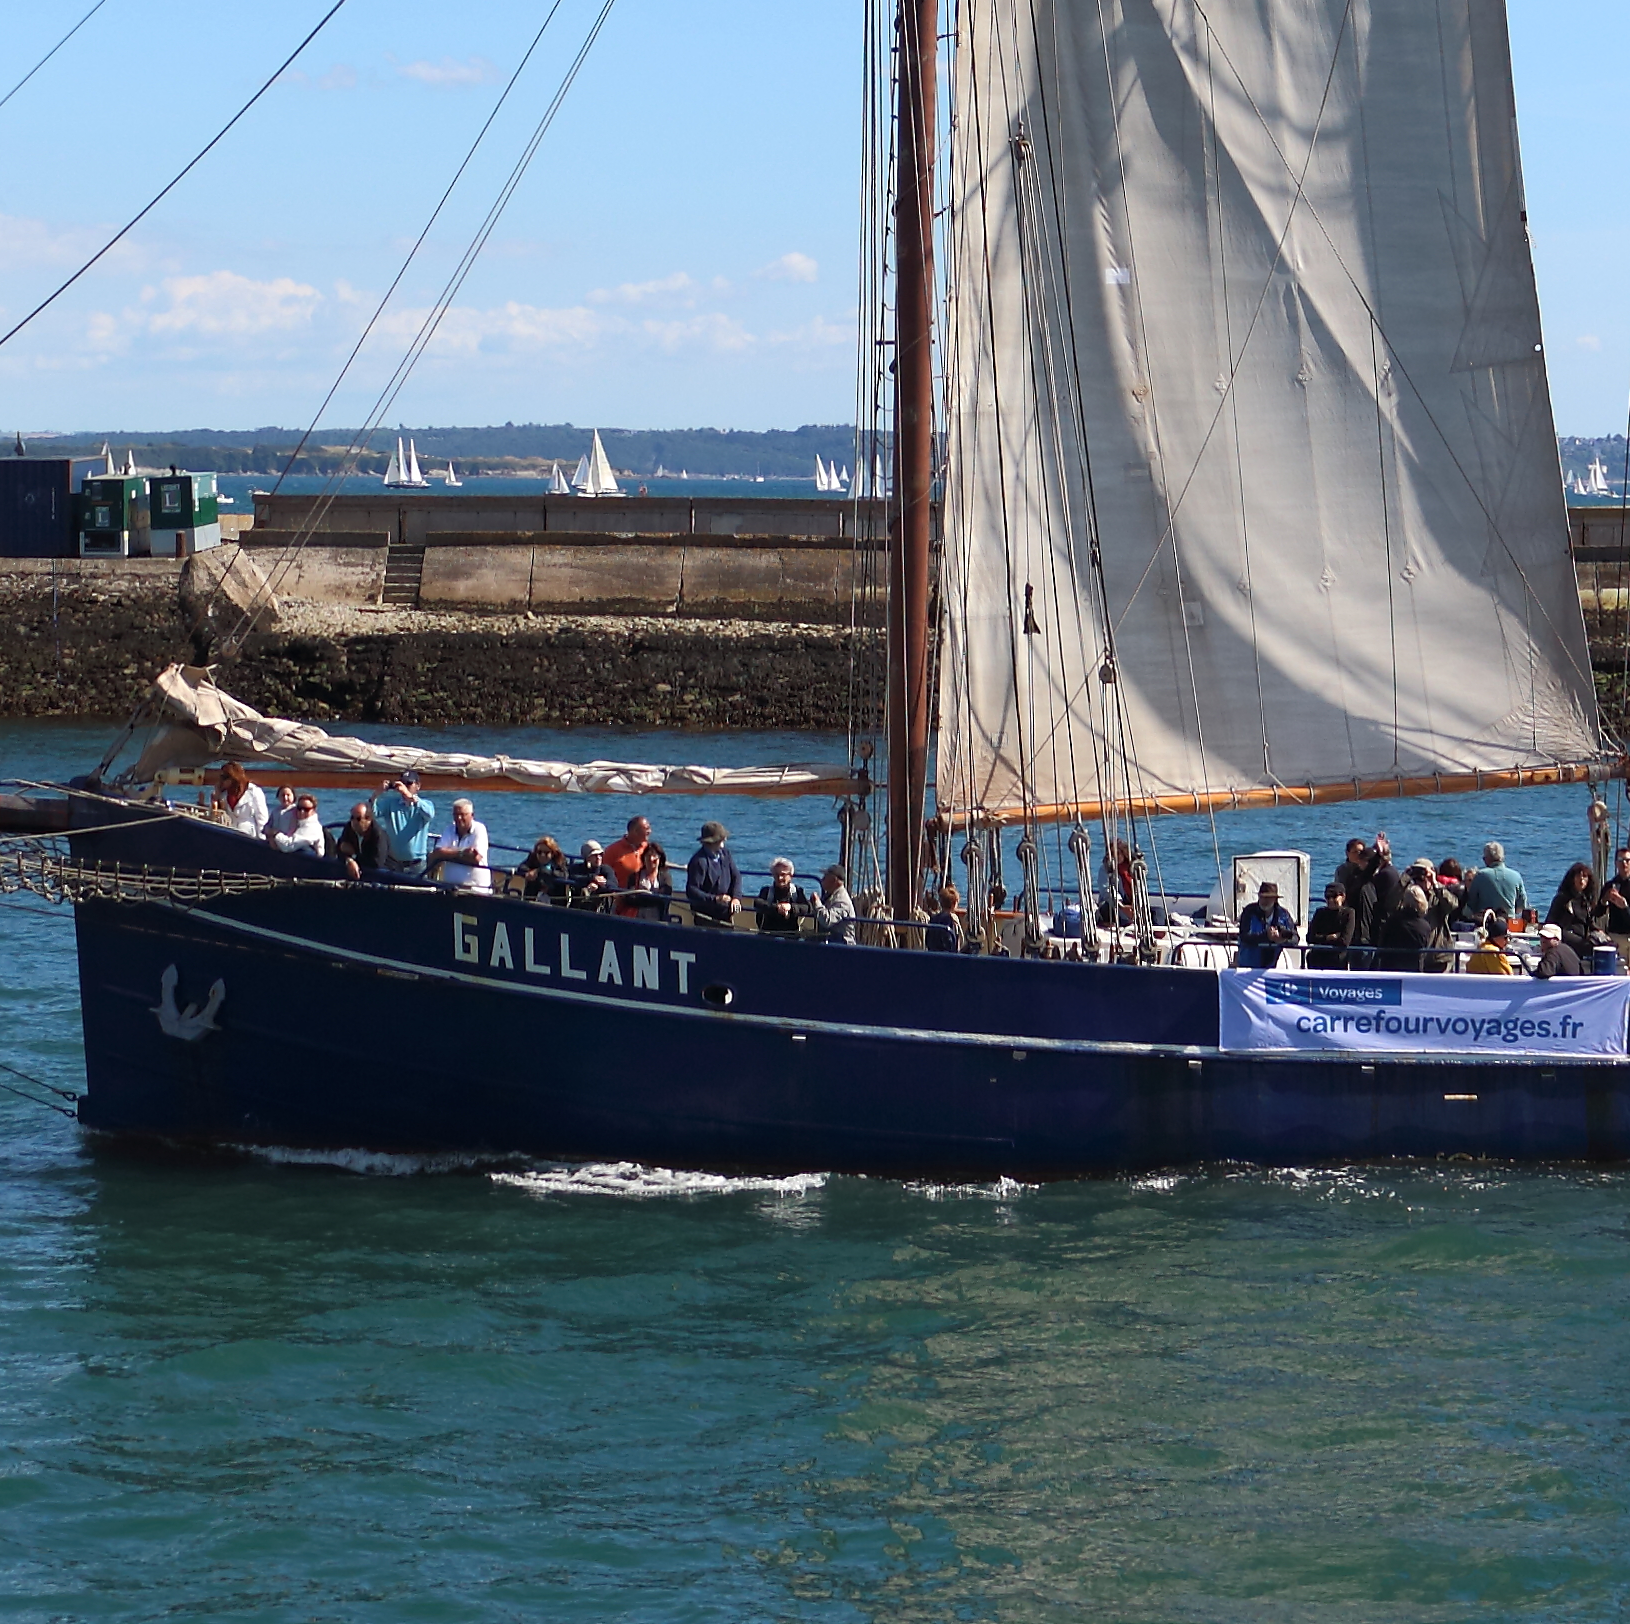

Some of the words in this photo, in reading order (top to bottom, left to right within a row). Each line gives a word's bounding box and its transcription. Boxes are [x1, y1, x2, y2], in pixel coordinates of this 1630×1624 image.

[453, 911, 696, 995] GALLANT
[1318, 986, 1384, 1001] Voyages
[1296, 1009, 1584, 1043] carrefourvoyages.fr
